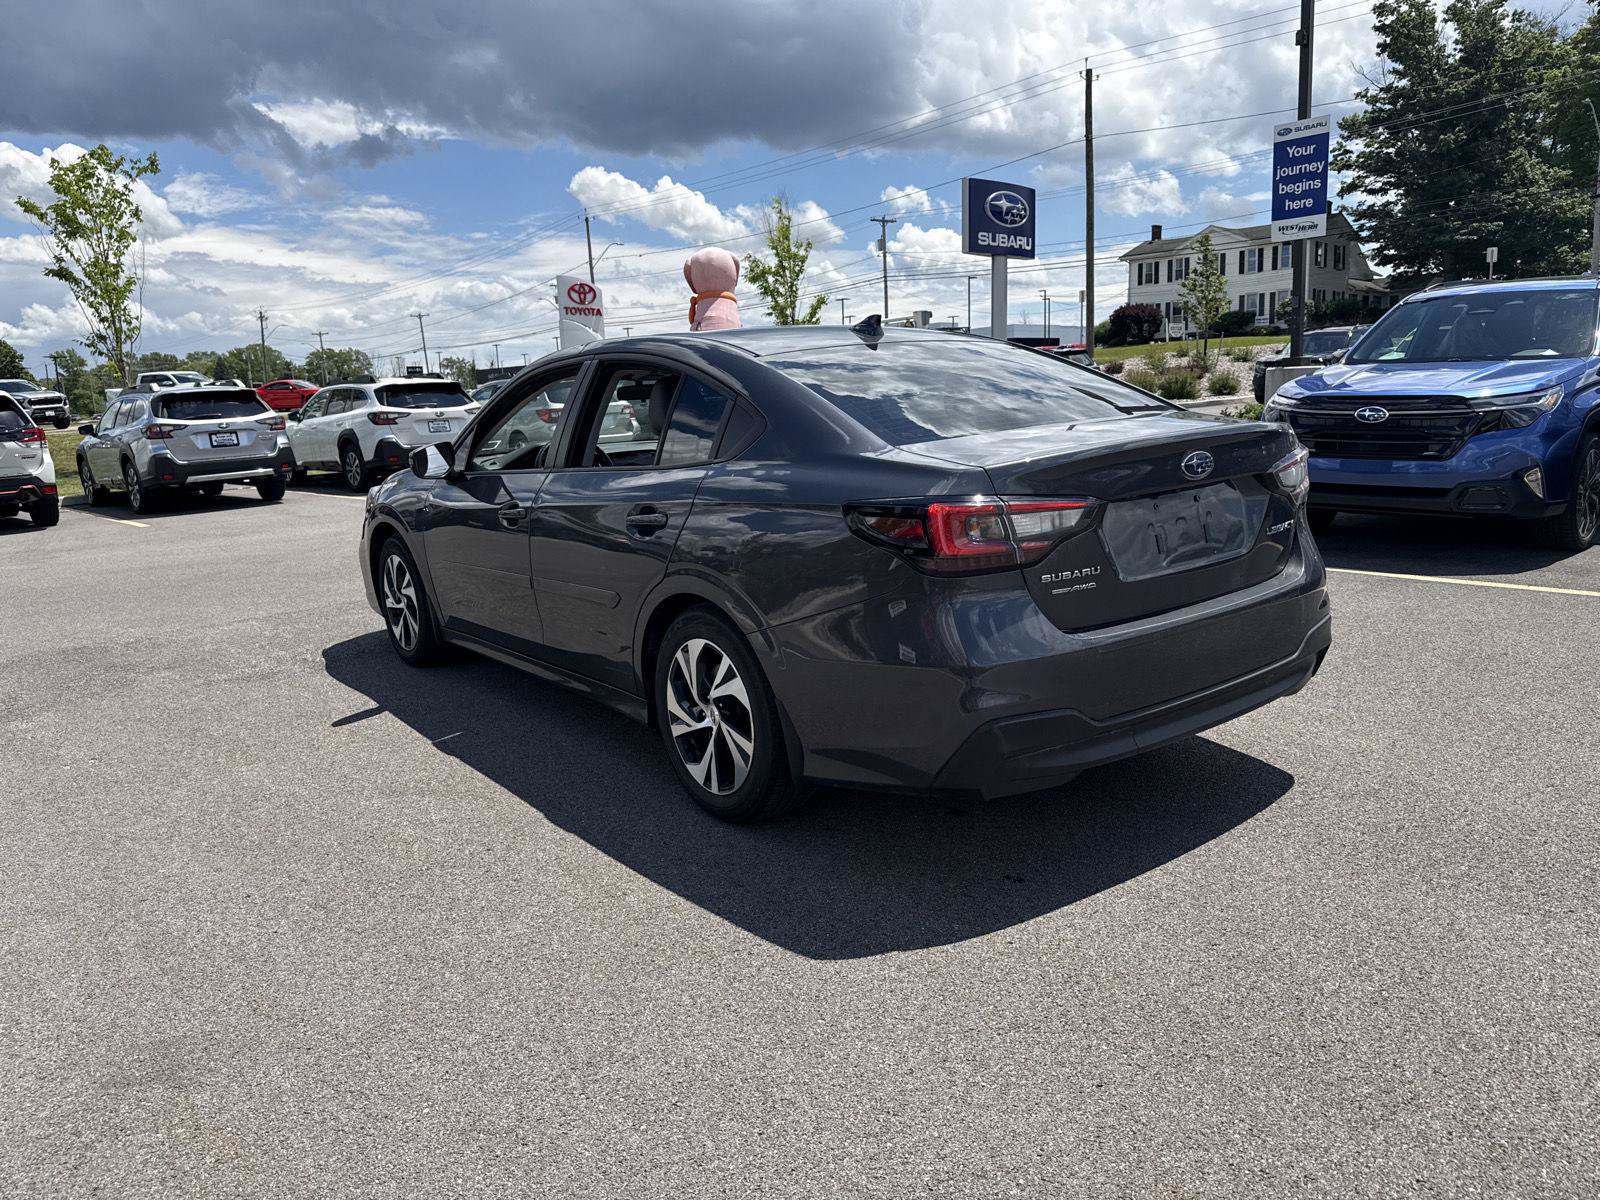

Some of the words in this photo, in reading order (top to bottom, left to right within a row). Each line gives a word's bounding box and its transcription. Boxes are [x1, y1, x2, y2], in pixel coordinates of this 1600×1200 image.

[1294, 121, 1327, 132] SUBARU
[1286, 144, 1316, 158] Your
[1276, 160, 1325, 180] journey
[1278, 178, 1321, 195] begins
[1285, 198, 1314, 211] here
[978, 232, 1032, 250] SUBARU
[563, 306, 603, 316] TOYOTA
[1041, 565, 1101, 583] SUBARU
